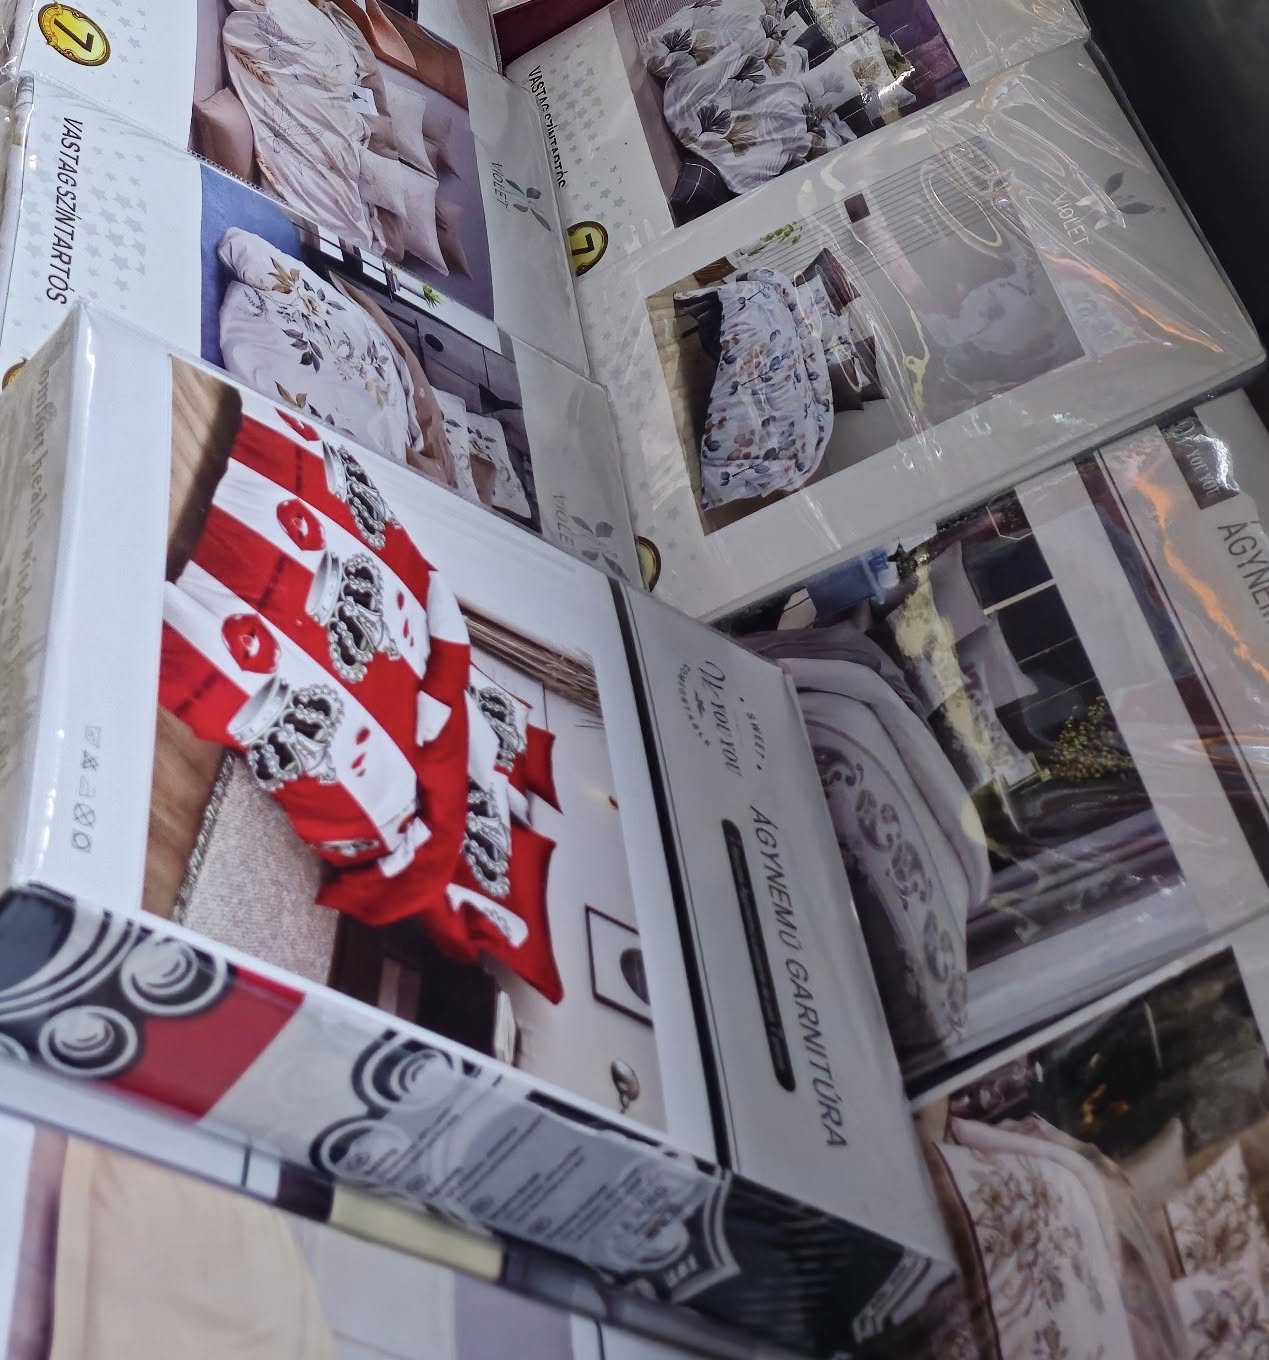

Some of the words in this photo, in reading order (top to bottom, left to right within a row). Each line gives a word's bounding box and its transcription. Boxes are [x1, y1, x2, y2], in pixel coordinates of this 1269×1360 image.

[53, 18, 95, 52] 7
[57, 117, 83, 186] VASTAG
[491, 161, 508, 209] VIOLET
[46, 188, 78, 305] SZÍNTARTÓS
[571, 233, 595, 256] 7
[785, 958, 848, 1148] GARNITÚRA
